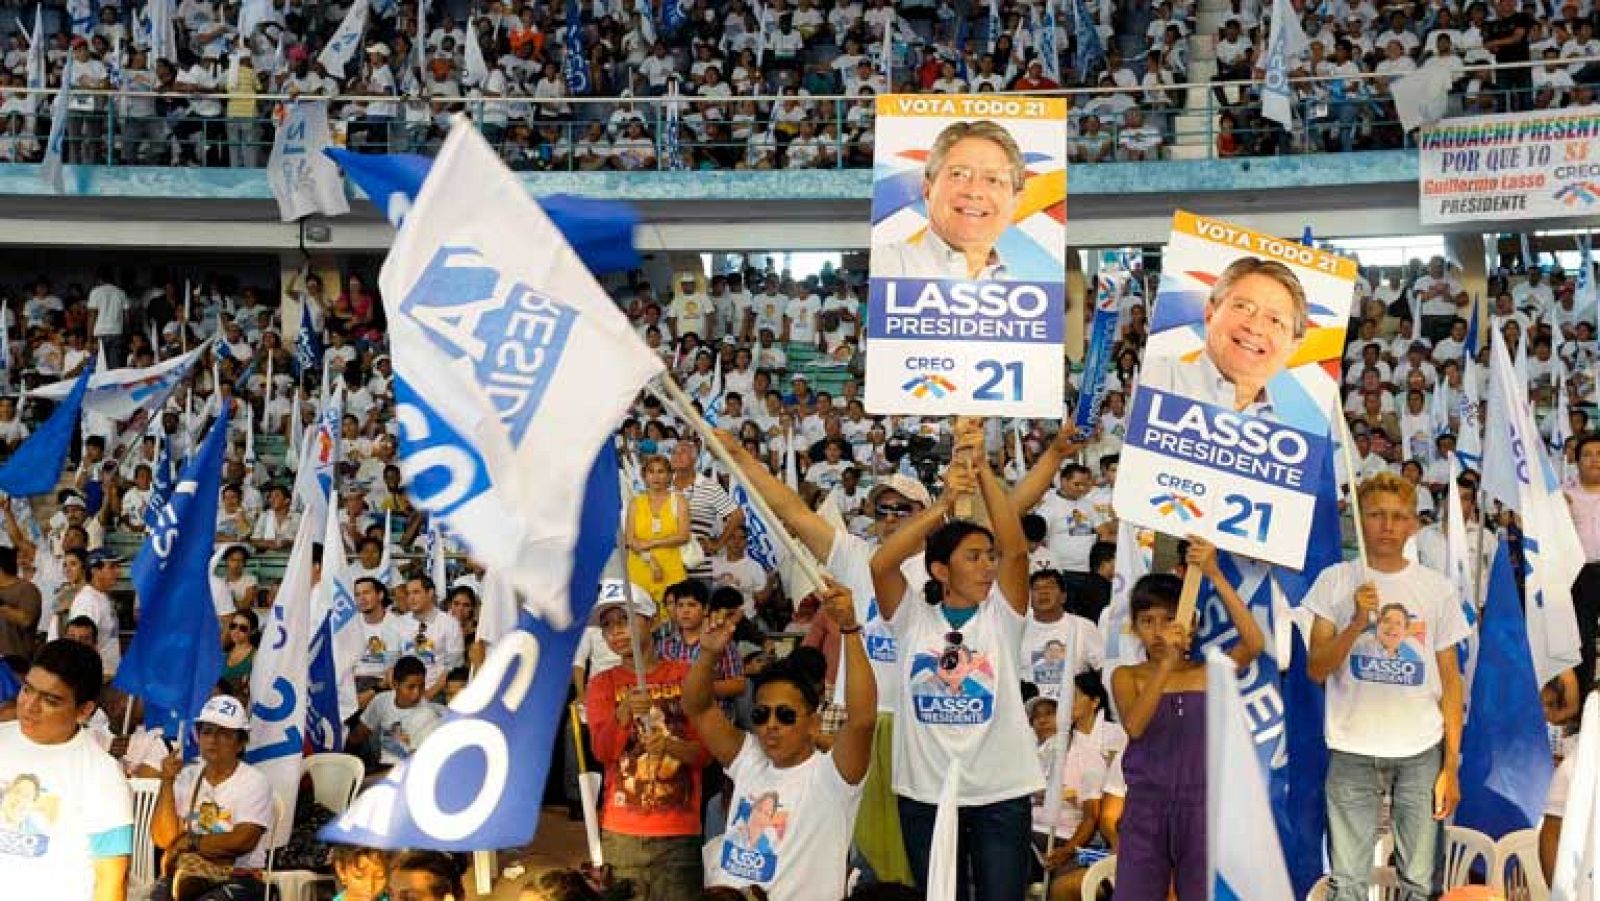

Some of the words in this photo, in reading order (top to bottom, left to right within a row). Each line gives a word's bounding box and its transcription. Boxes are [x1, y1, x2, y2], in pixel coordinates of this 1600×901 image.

[899, 98, 956, 114] VOTA
[963, 99, 1020, 116] TODO
[1023, 101, 1045, 116] 21
[1441, 149, 1480, 173] POR
[1487, 146, 1520, 172] QUE
[1526, 143, 1551, 168] YO
[1440, 194, 1528, 216] PRESIDENTE
[1195, 218, 1251, 248] VOTA
[1258, 236, 1314, 264] TODO
[1317, 254, 1338, 274] 21
[885, 281, 1050, 319] LASSO
[885, 316, 1048, 340] PRESIDENTE
[904, 356, 955, 371] CREO
[971, 359, 1024, 401] 21
[1146, 392, 1310, 465] LASSO
[1143, 428, 1304, 486] PRESIDENTE
[1155, 472, 1207, 496] CREO
[1216, 493, 1274, 543] 21
[219, 701, 237, 717] 21
[918, 694, 985, 713] LASSO
